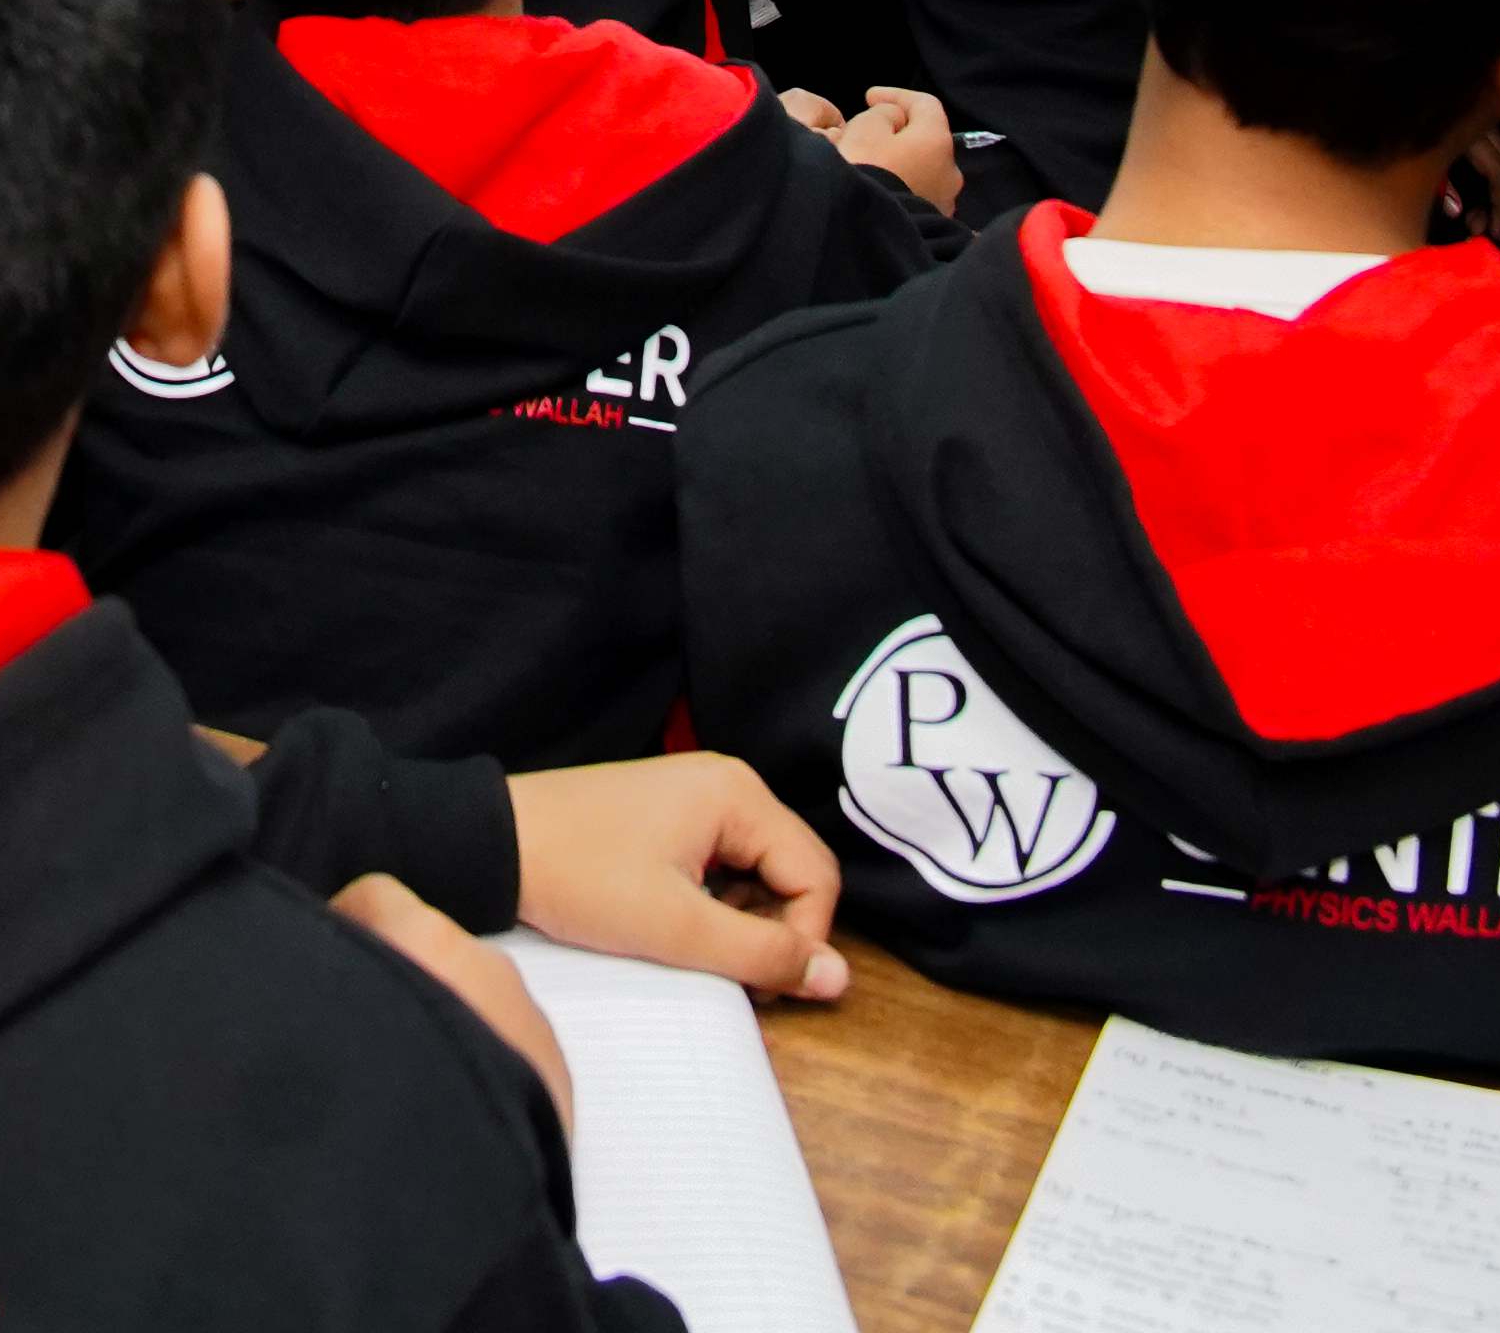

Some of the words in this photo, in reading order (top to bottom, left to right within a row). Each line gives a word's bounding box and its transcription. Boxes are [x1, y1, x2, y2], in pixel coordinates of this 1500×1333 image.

[513, 396, 624, 430] WALLAH
[885, 668, 1074, 882] PW
[1251, 879, 1399, 932] PHYSICS
